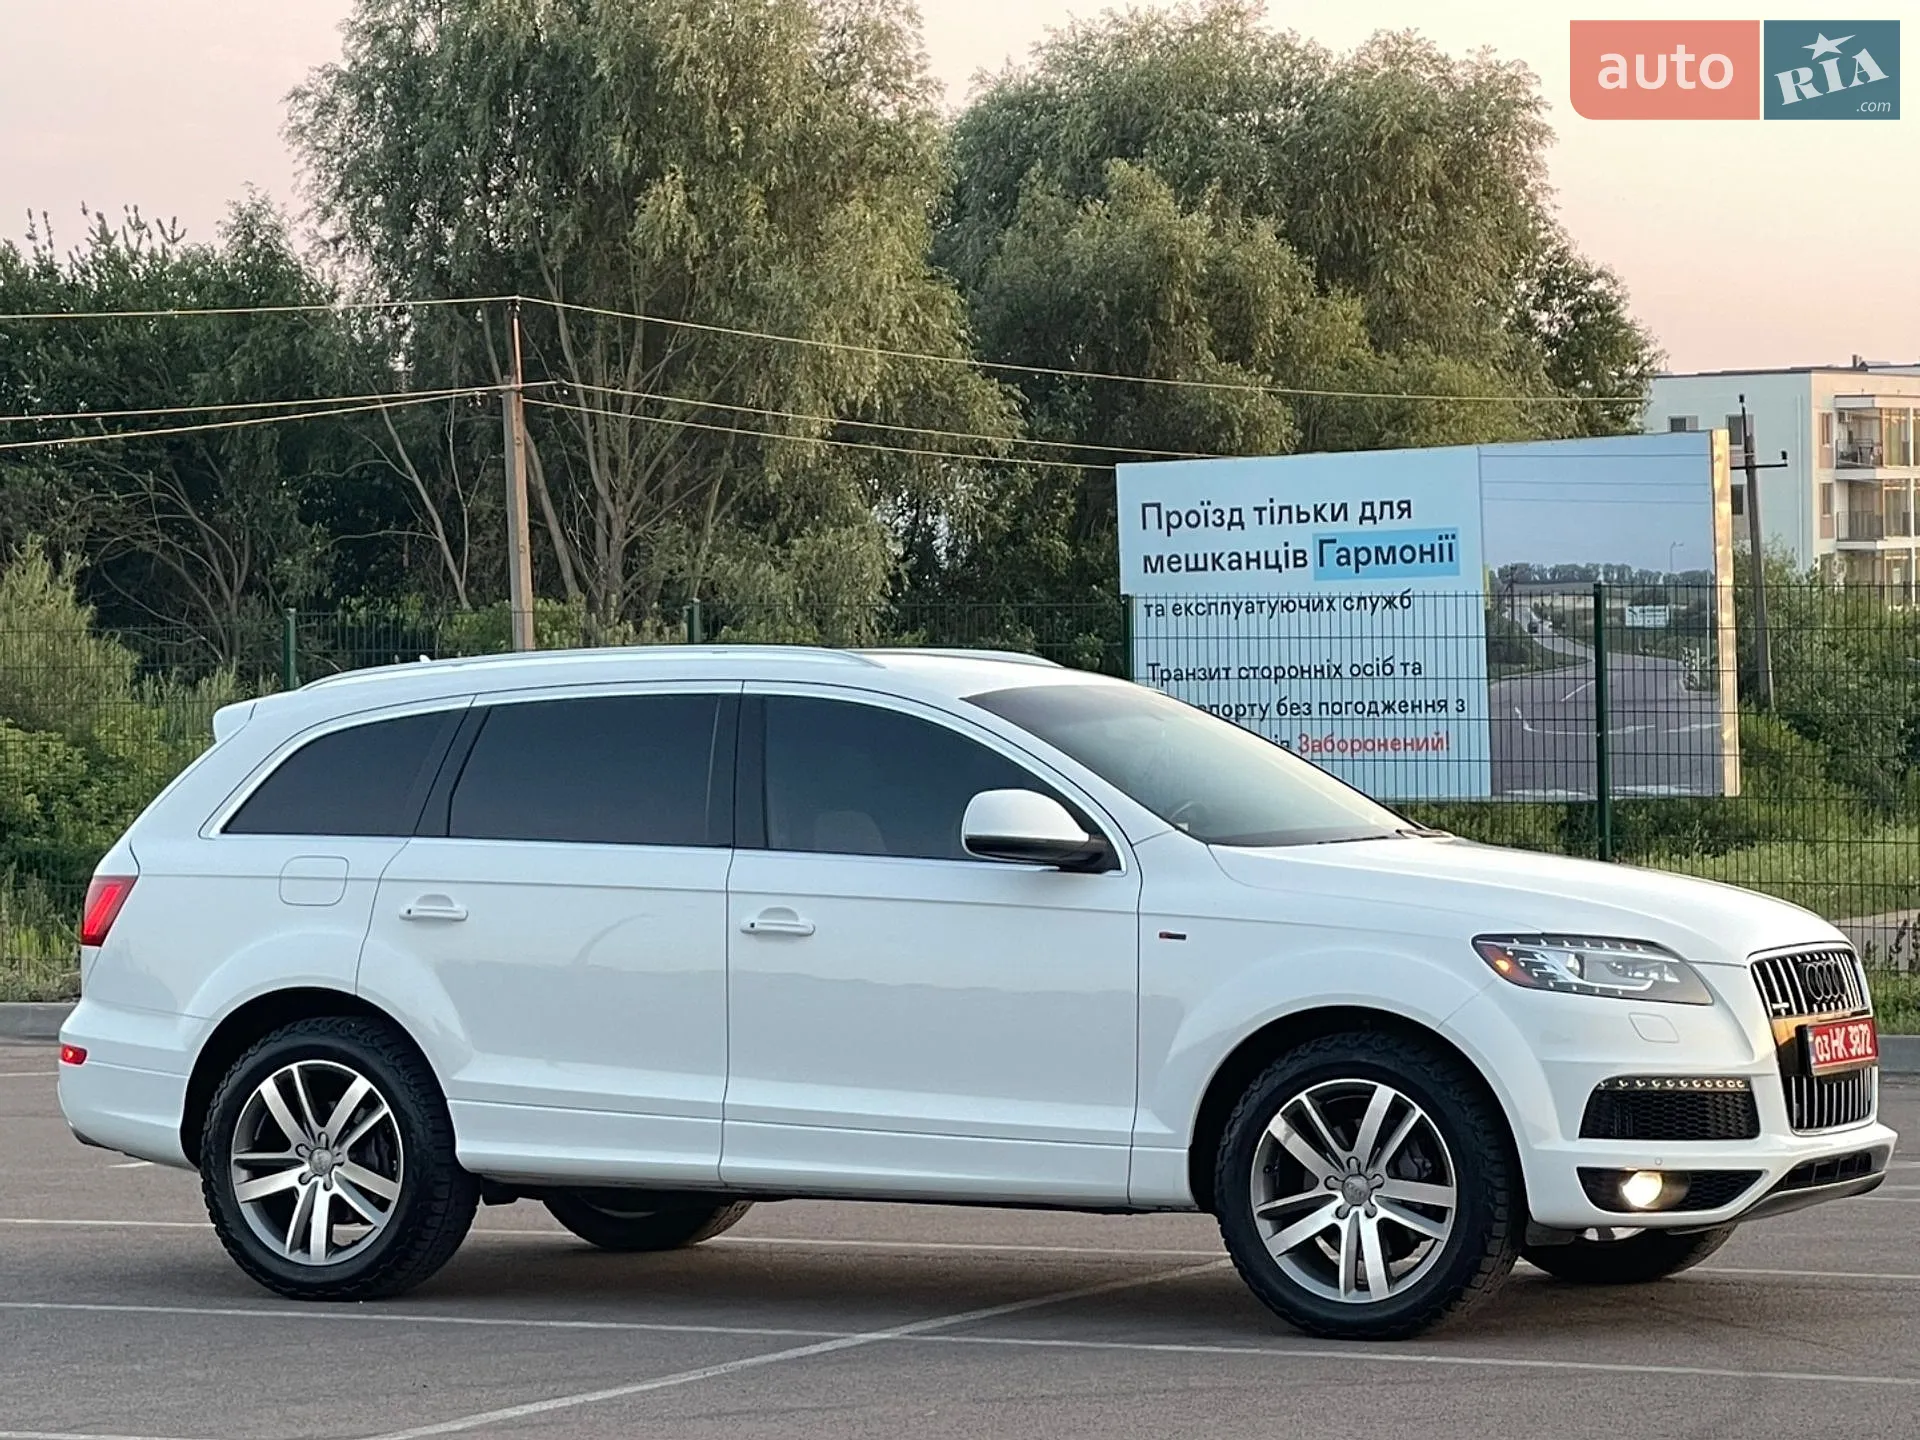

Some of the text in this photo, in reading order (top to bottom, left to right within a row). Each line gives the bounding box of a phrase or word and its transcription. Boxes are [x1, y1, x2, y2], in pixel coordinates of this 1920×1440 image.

[1141, 498, 1413, 537] Проїзд тільки для
[1143, 534, 1457, 574] мешканців Гармонії
[1144, 588, 1412, 620] та експлуатуючих служб
[1146, 655, 1423, 686] Транзит сторонніх осіб та
[1276, 696, 1312, 717] без
[1318, 699, 1448, 718] погодження
[1455, 698, 1466, 713] з
[1298, 731, 1450, 755] Заборонений!
